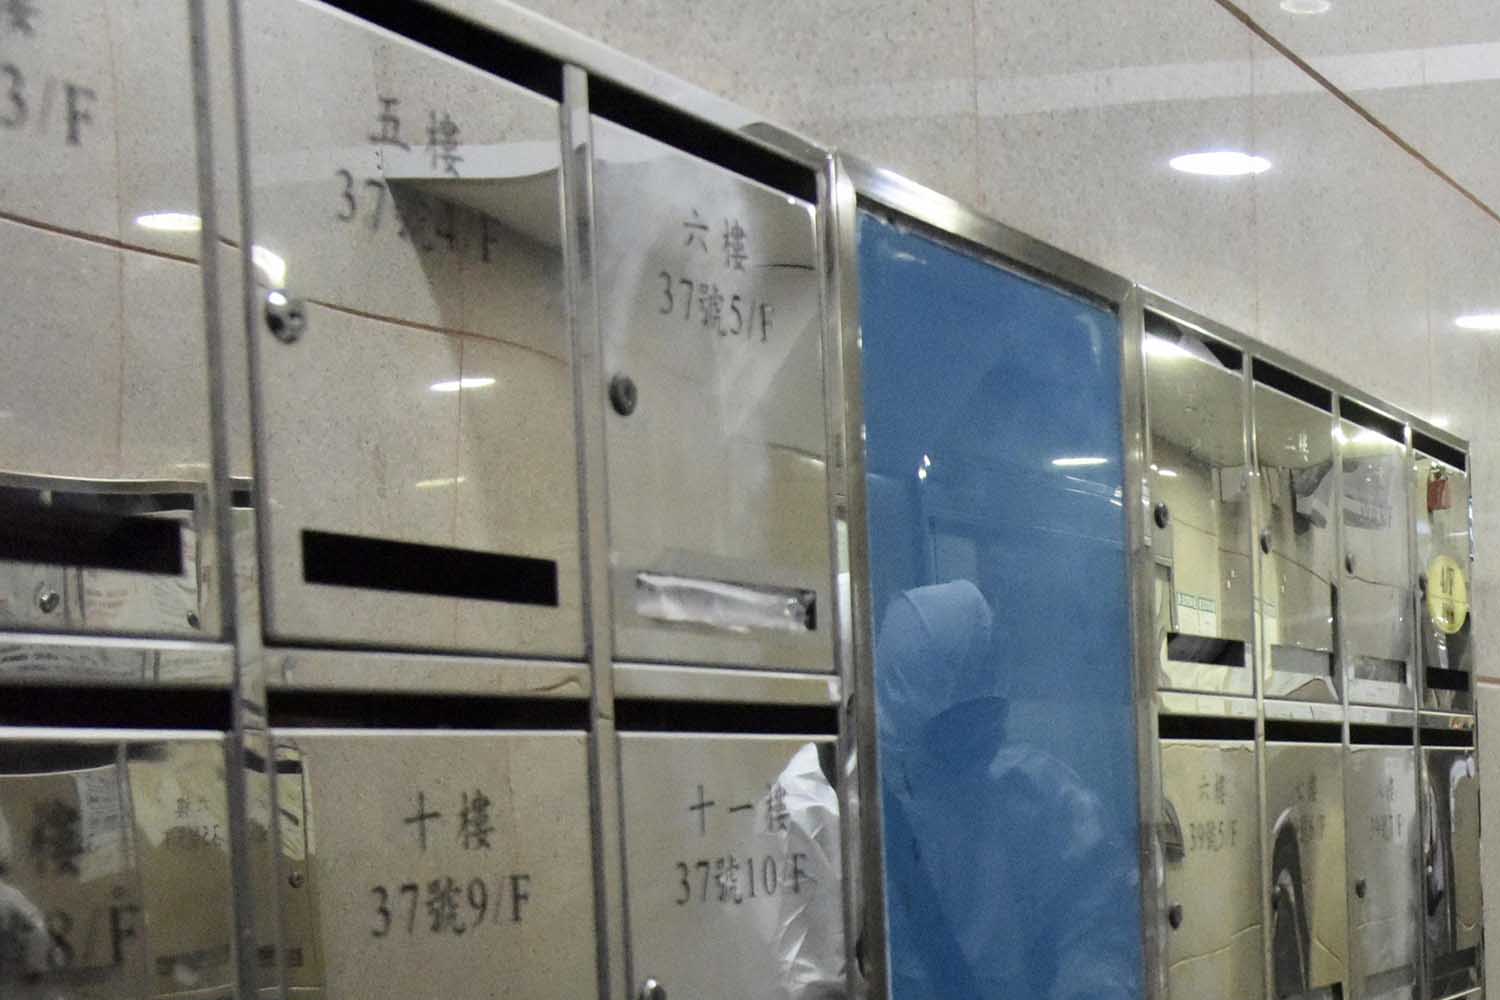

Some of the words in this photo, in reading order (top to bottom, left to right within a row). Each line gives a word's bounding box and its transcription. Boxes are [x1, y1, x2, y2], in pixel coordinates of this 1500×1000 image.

[369, 97, 464, 178] 五樓
[683, 209, 748, 272] 六樓
[659, 271, 776, 343] 37號5/F
[404, 789, 495, 850] 十樓
[688, 783, 790, 834] 十一樓
[371, 874, 532, 938] 37號9/F
